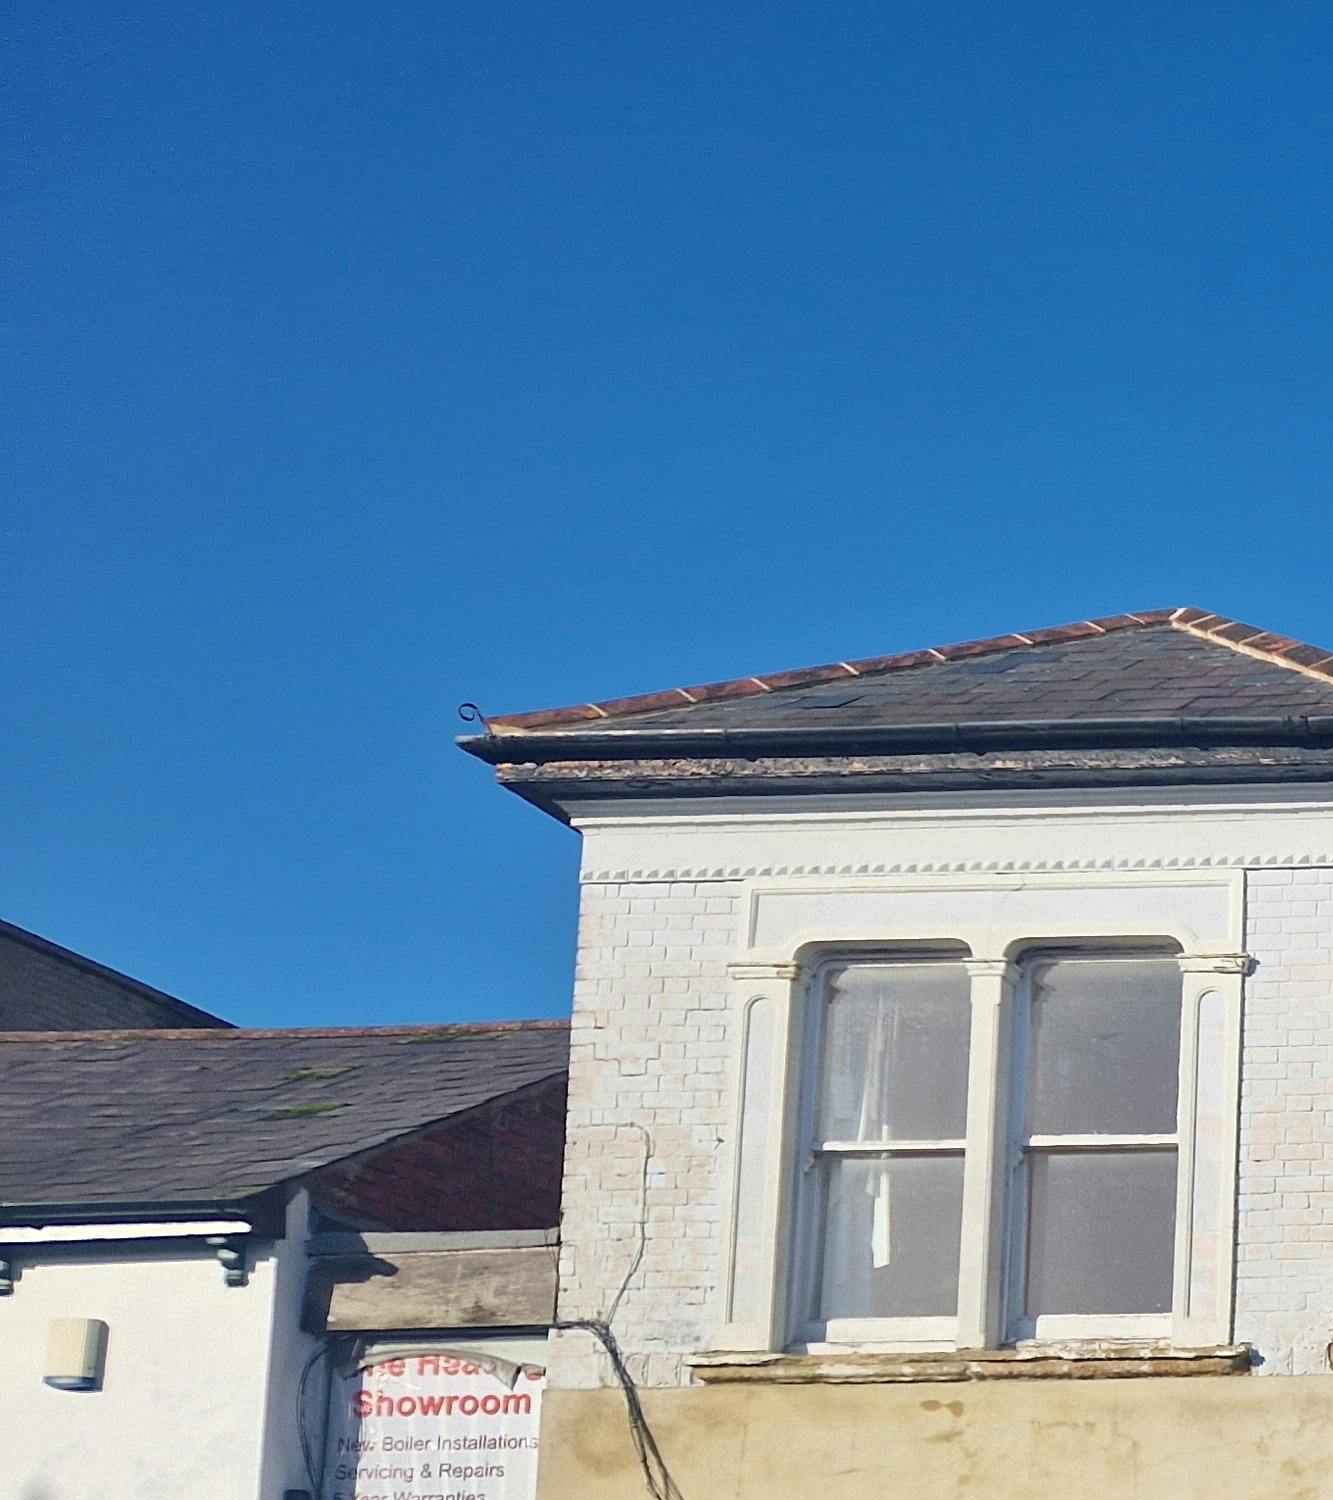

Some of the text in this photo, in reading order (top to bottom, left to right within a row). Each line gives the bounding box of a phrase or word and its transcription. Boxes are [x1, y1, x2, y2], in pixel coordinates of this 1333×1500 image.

[352, 1389, 531, 1418] Showroom
[382, 1436, 430, 1452] Boiler
[437, 1435, 539, 1451] Installations
[334, 1463, 505, 1482] Servicing & Repairs
